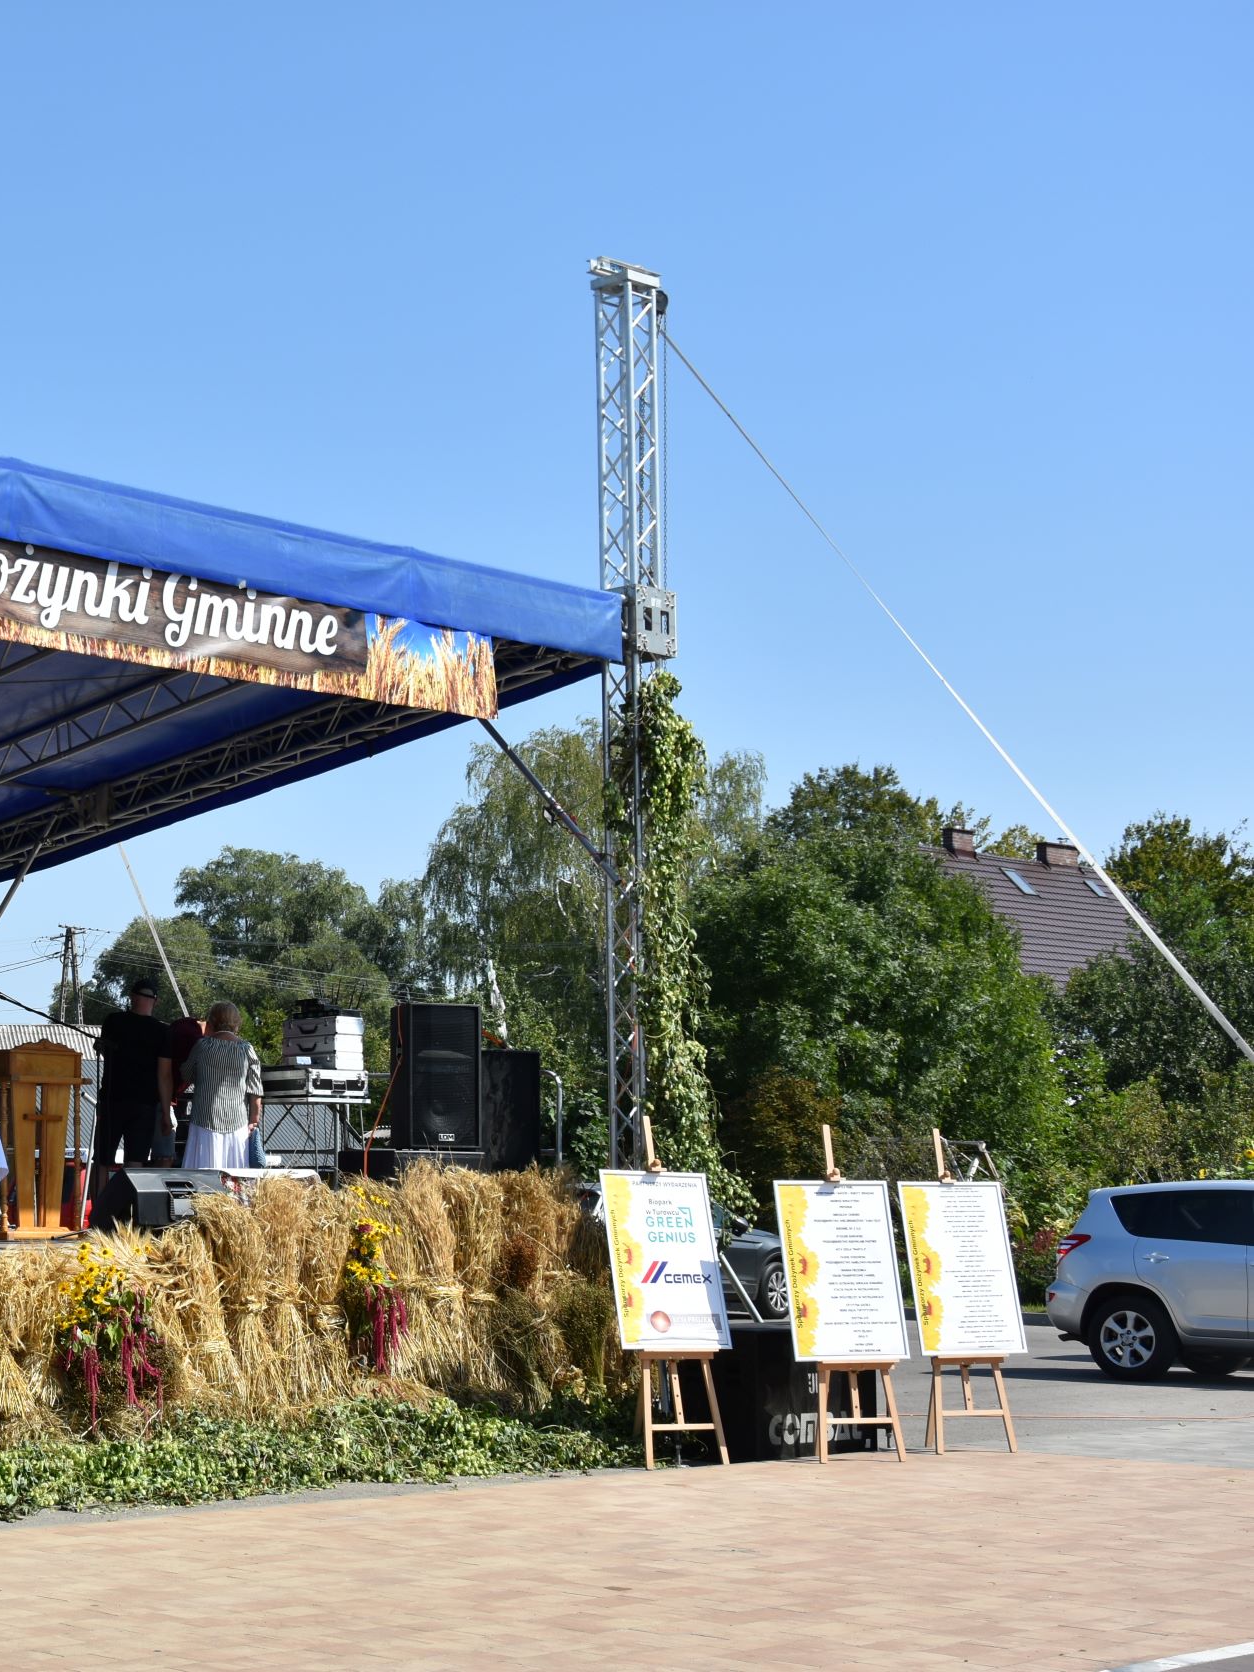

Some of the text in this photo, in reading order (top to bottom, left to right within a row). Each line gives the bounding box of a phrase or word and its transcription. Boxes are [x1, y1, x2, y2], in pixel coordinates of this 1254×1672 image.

[162, 572, 338, 656] Gminne
[648, 1199, 672, 1207] Biopark
[610, 1209, 619, 1246] Gminnych
[646, 1211, 693, 1228] GREEN
[648, 1231, 696, 1243] GENIUS
[785, 1219, 794, 1256] Gminnych
[908, 1220, 918, 1256] Gminnych
[615, 1247, 624, 1278] Dożynek
[789, 1257, 798, 1289] Dożynek
[914, 1257, 923, 1287] Dożynek
[664, 1273, 712, 1284] CEMEX
